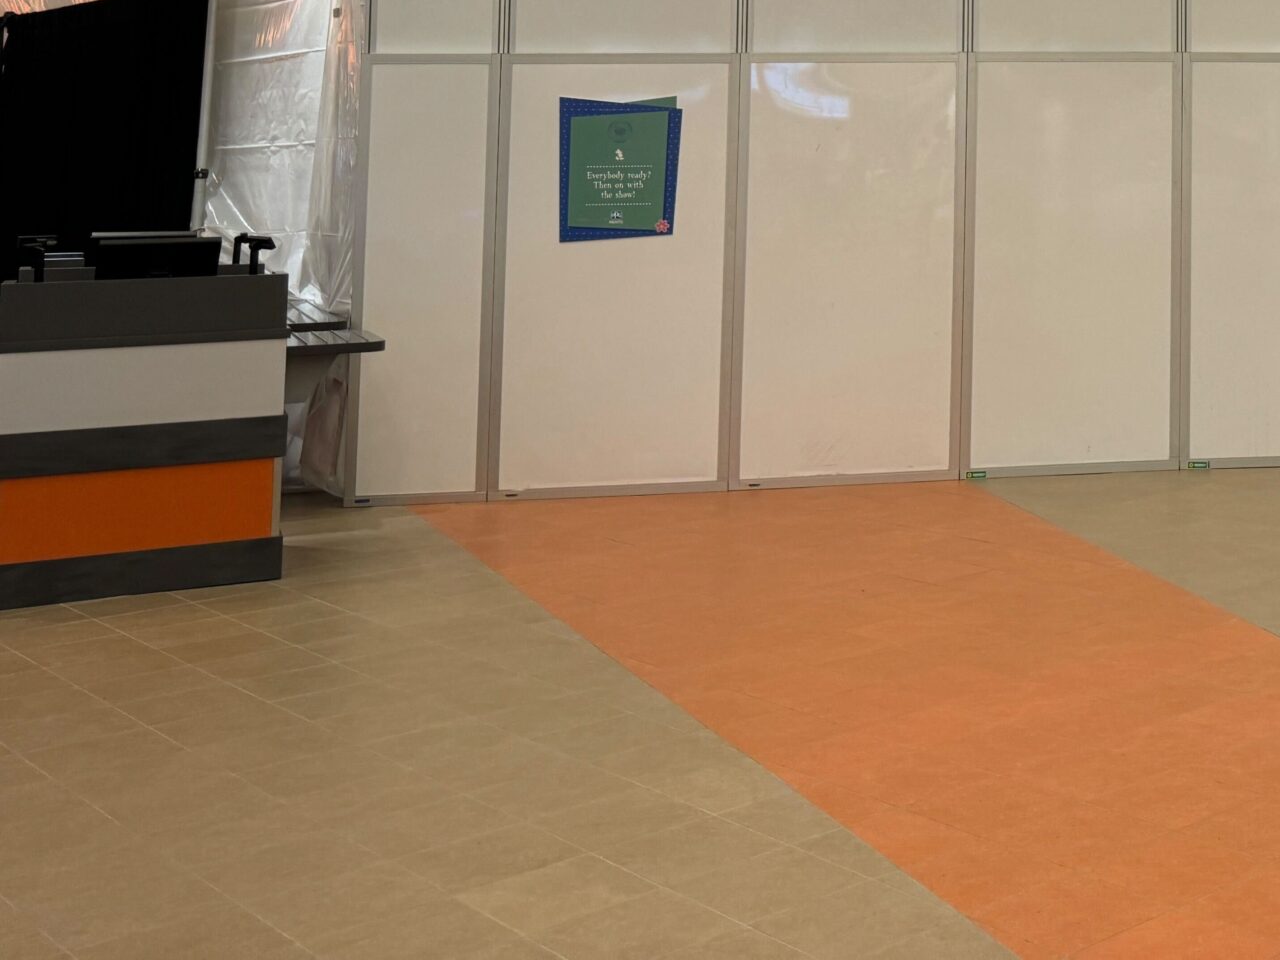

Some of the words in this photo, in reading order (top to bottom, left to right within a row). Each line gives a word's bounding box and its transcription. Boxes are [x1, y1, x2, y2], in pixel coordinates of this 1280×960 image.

[586, 171, 625, 181] Everybody
[627, 171, 652, 180] ready?
[592, 181, 612, 189] Then
[627, 180, 644, 189] with
[600, 190, 613, 199] the
[615, 190, 636, 199] show!
